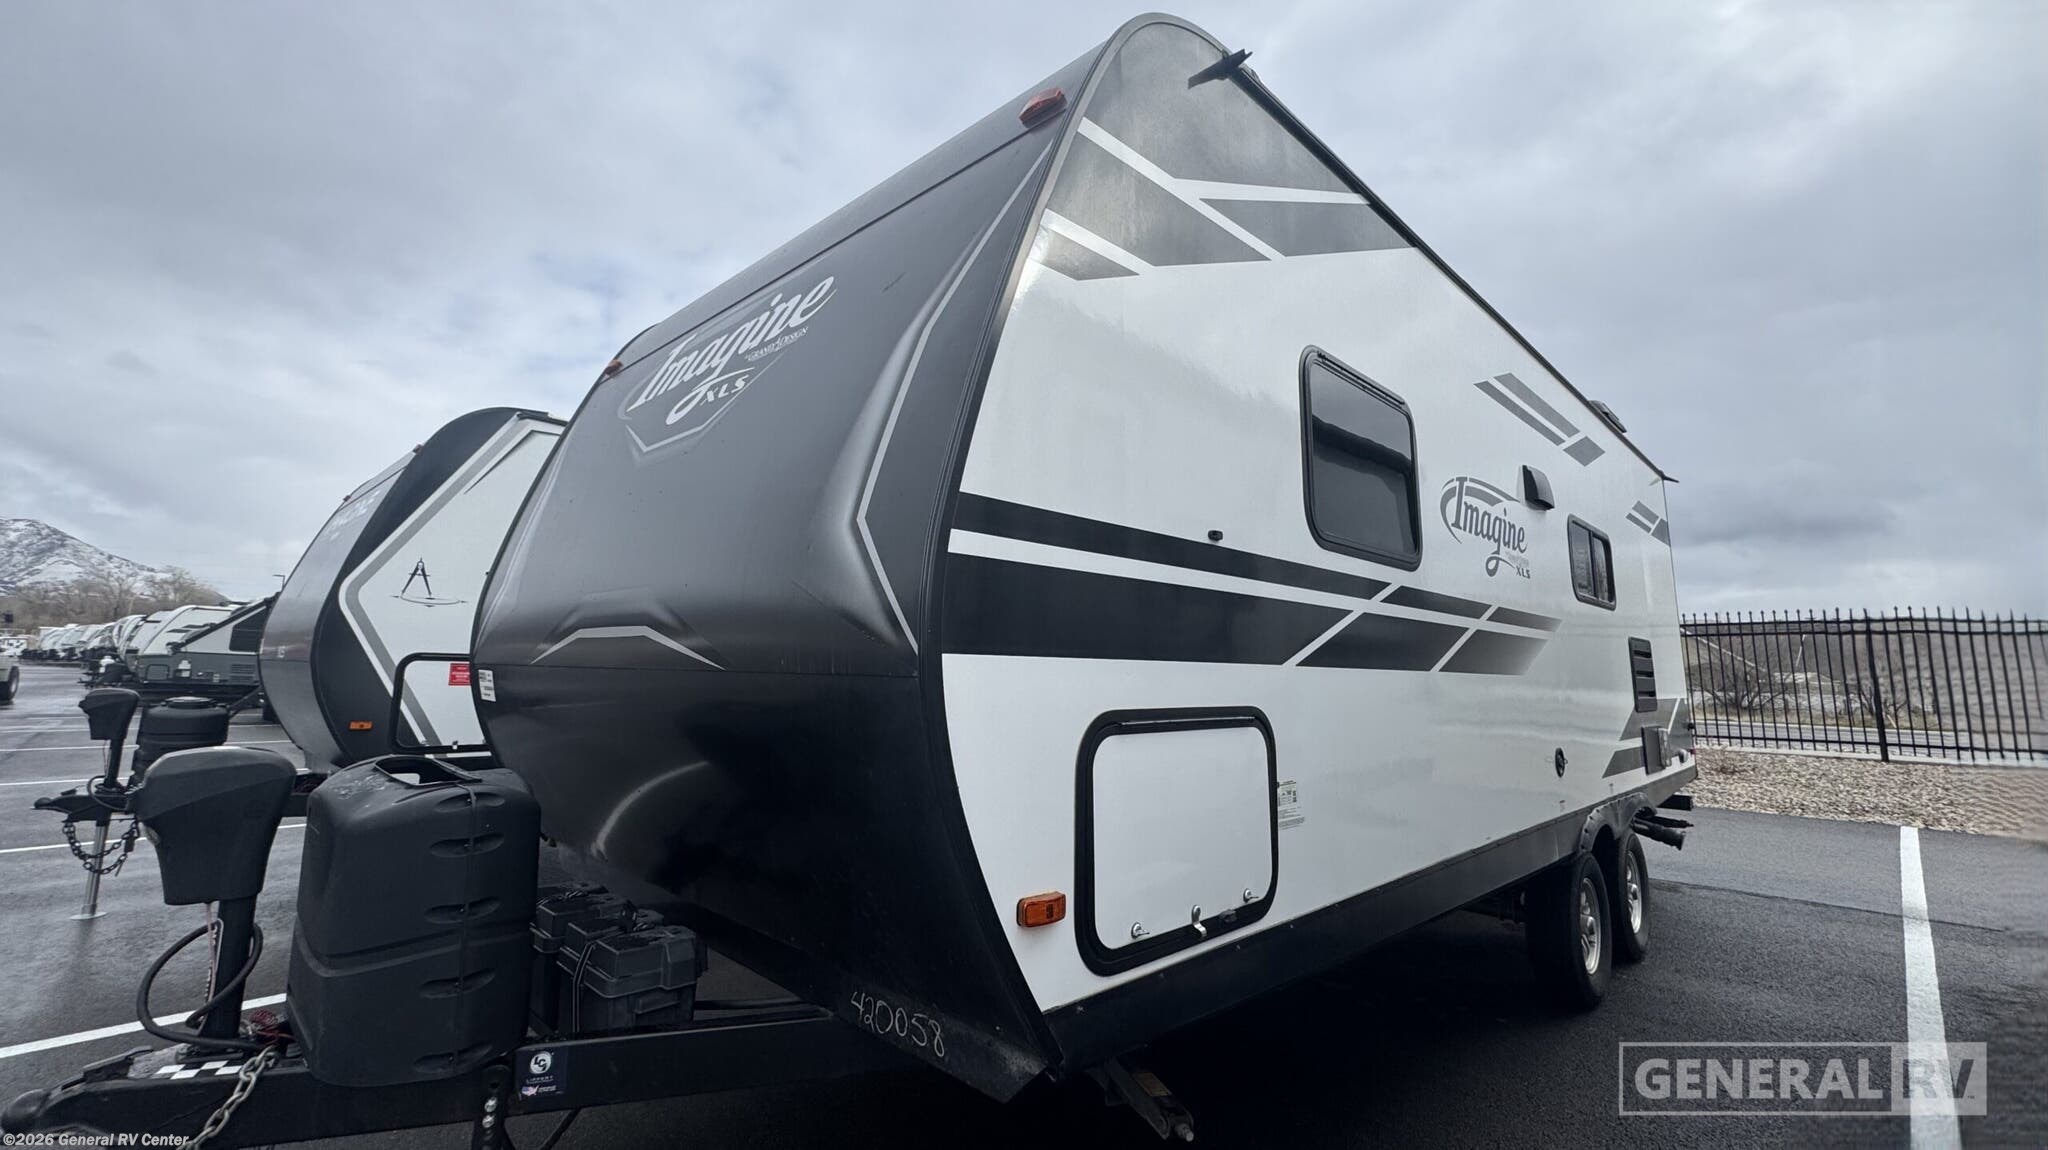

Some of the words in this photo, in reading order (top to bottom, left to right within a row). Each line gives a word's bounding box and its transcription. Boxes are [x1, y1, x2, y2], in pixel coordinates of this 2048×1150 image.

[626, 276, 837, 425] Imagine
[700, 374, 749, 406] XLS
[1450, 477, 1528, 577] Imagine
[1516, 565, 1530, 579] XLS
[851, 992, 945, 1057] 420058
